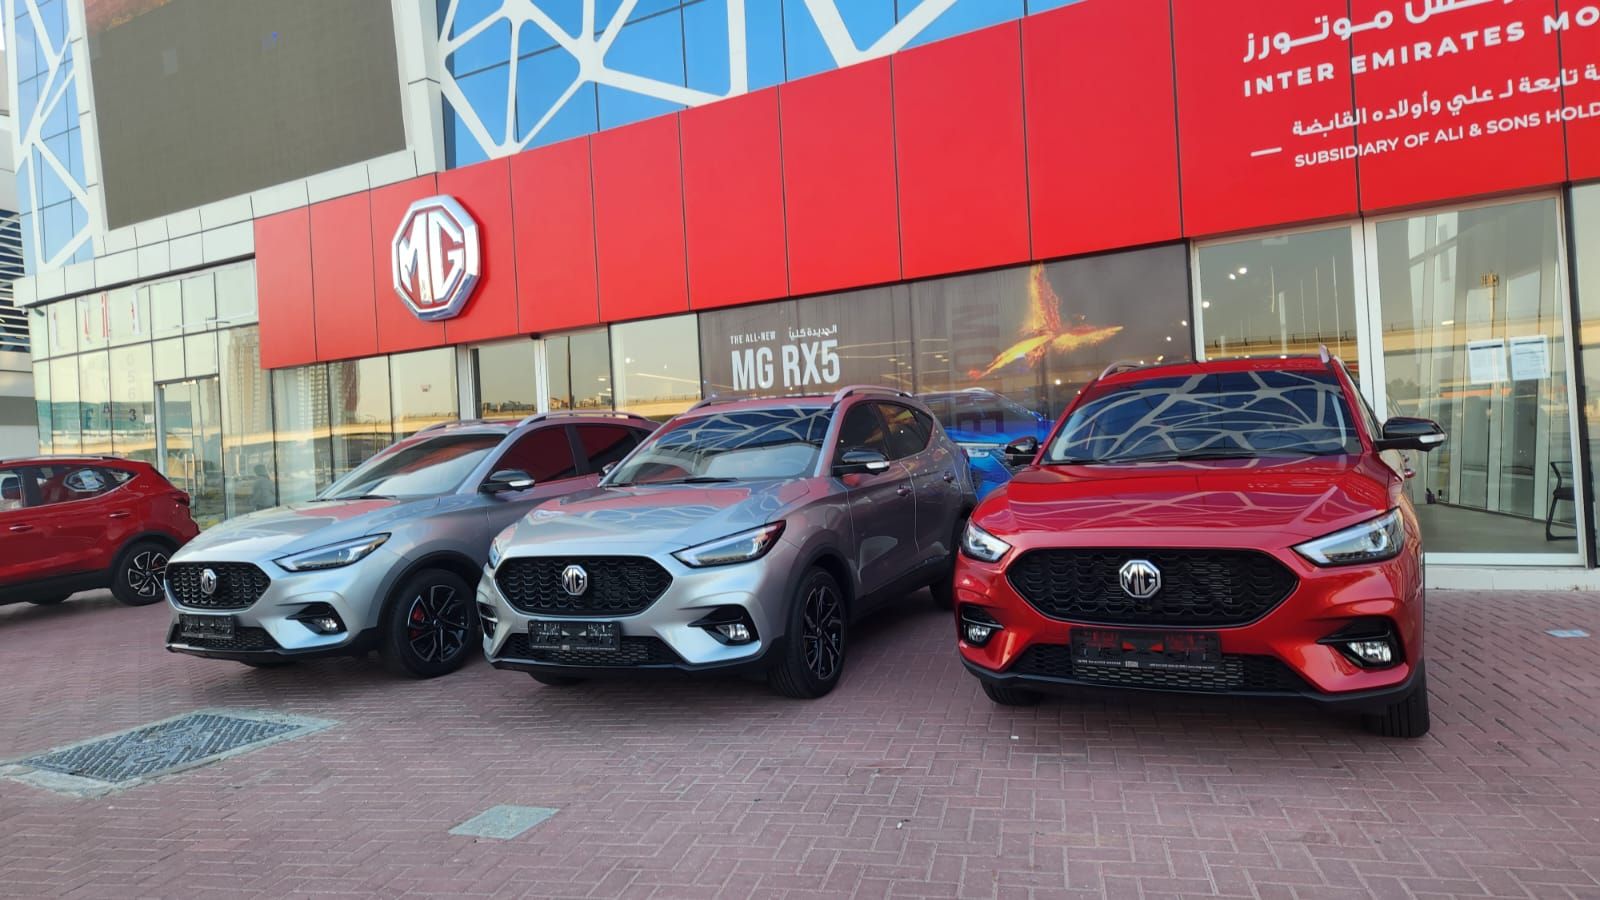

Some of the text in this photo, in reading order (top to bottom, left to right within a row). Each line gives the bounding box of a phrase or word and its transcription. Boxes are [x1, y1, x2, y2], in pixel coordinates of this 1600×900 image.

[1243, 10, 1394, 63] موتورز
[1244, 62, 1335, 97] INTER
[1351, 21, 1525, 75] EMIRATES
[1518, 68, 1579, 94] تابعة
[1372, 90, 1441, 122] وأولاده
[1447, 86, 1494, 117] علي
[1292, 107, 1367, 138] القابضة
[1295, 137, 1399, 168] SUBSIDIARY
[1404, 132, 1430, 149] OF
[1434, 126, 1464, 144] ALI
[1469, 123, 1482, 138] &
[1486, 112, 1541, 135] SONS
[397, 209, 467, 306] MG
[730, 335, 743, 345] THE
[731, 339, 840, 391] MG RX5
[563, 567, 586, 594] MG
[1122, 562, 1158, 597] MG
